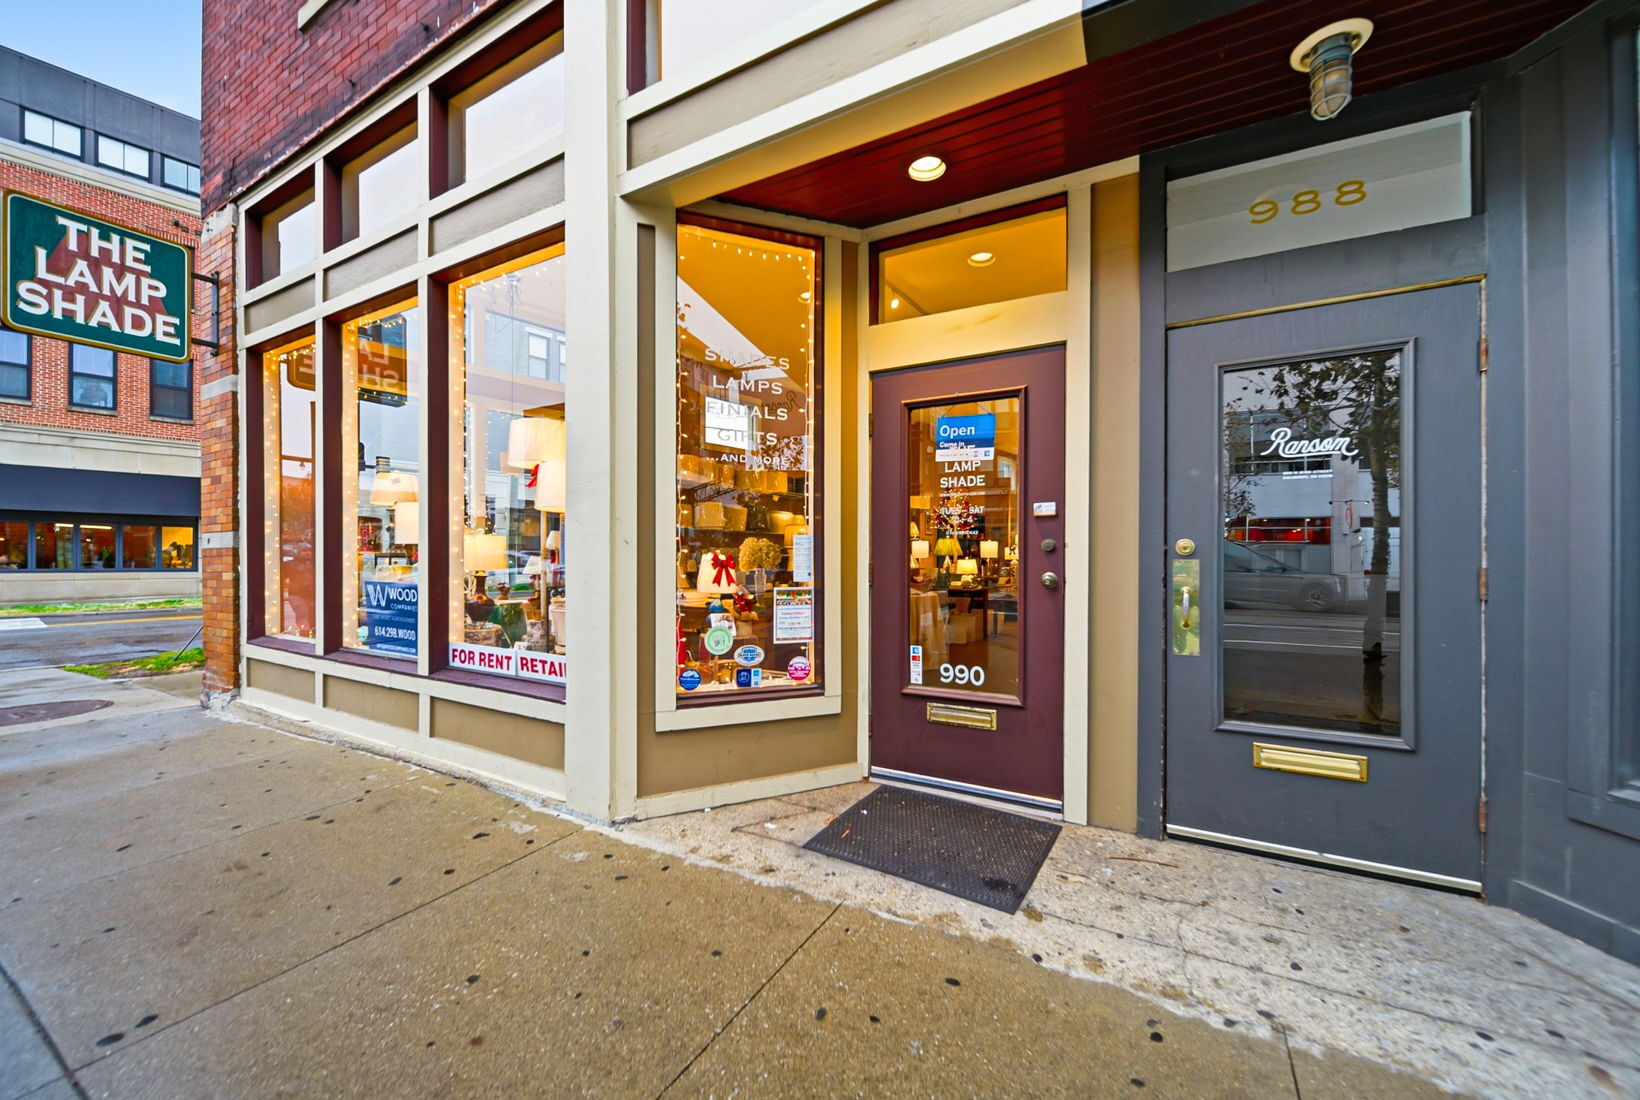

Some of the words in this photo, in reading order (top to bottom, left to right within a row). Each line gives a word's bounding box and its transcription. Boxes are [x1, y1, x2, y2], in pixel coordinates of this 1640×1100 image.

[1249, 179, 1367, 224] 988
[56, 214, 152, 273] THE
[35, 245, 167, 306] LAMP
[16, 280, 180, 346] SHADE
[713, 375, 783, 395] LAMPS
[706, 401, 788, 420] FINIALS
[718, 430, 778, 446] GIFTS
[940, 425, 975, 439] Open
[1260, 427, 1359, 458] Ransom
[753, 456, 789, 466] MORE
[944, 460, 981, 473] LAMP
[940, 475, 985, 489] SHADE
[969, 506, 985, 514] SAT
[388, 587, 418, 602] WOOD
[452, 648, 475, 666] FOR
[479, 652, 512, 671] RENT
[520, 656, 567, 678] RETAI
[940, 663, 985, 686] 990
